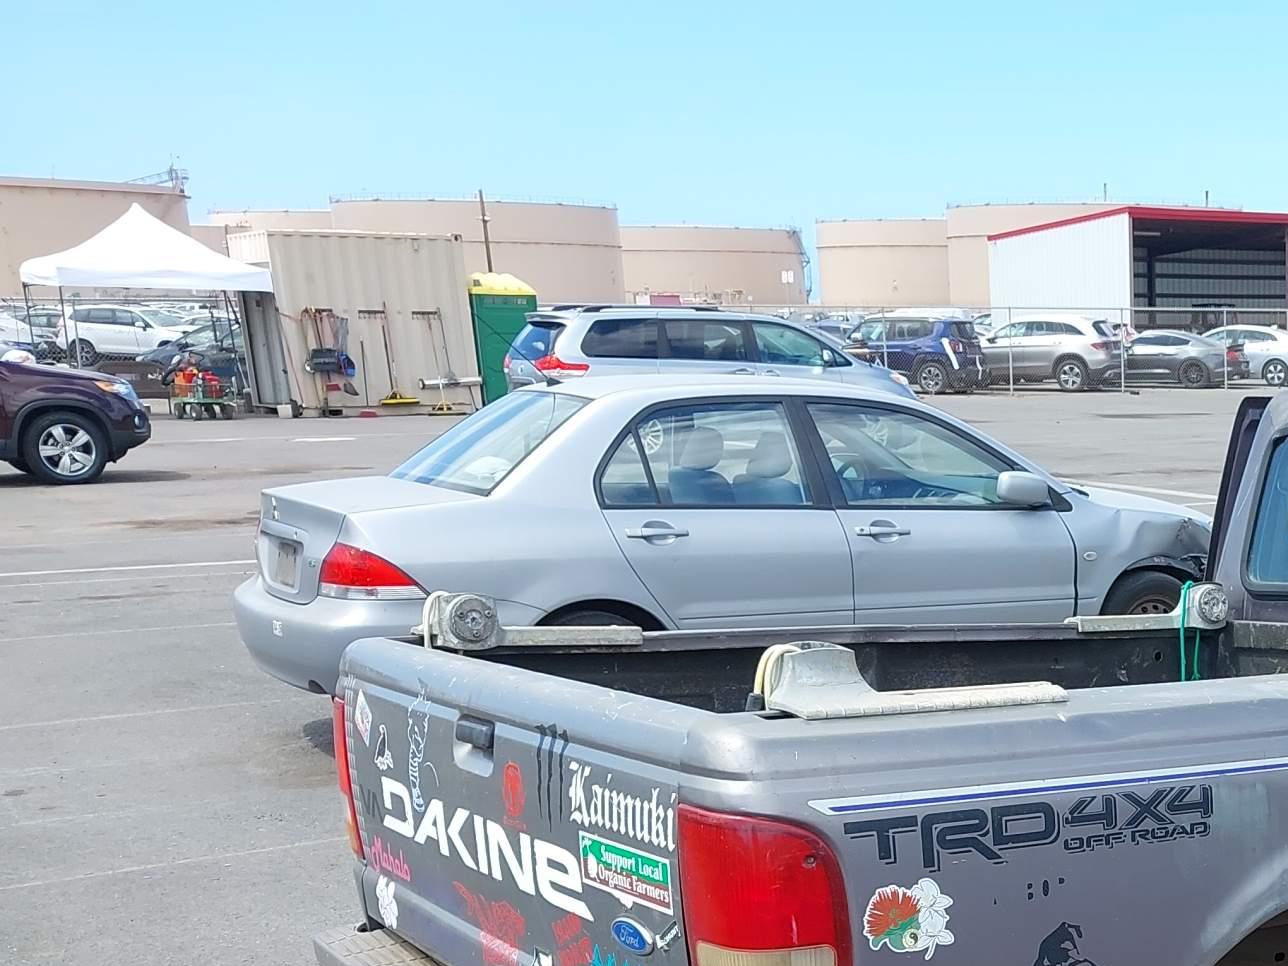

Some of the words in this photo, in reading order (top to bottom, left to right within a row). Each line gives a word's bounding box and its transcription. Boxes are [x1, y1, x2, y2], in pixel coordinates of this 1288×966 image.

[569, 761, 676, 853] Kaimuki
[844, 801, 1062, 873] TRD
[1063, 830, 1127, 854] OFF
[1130, 821, 1211, 846] ROAD
[600, 844, 637, 872] Support
[638, 858, 663, 882] Local
[599, 863, 632, 890] Organic
[632, 876, 670, 904] Farmers
[619, 924, 643, 948] Ford
